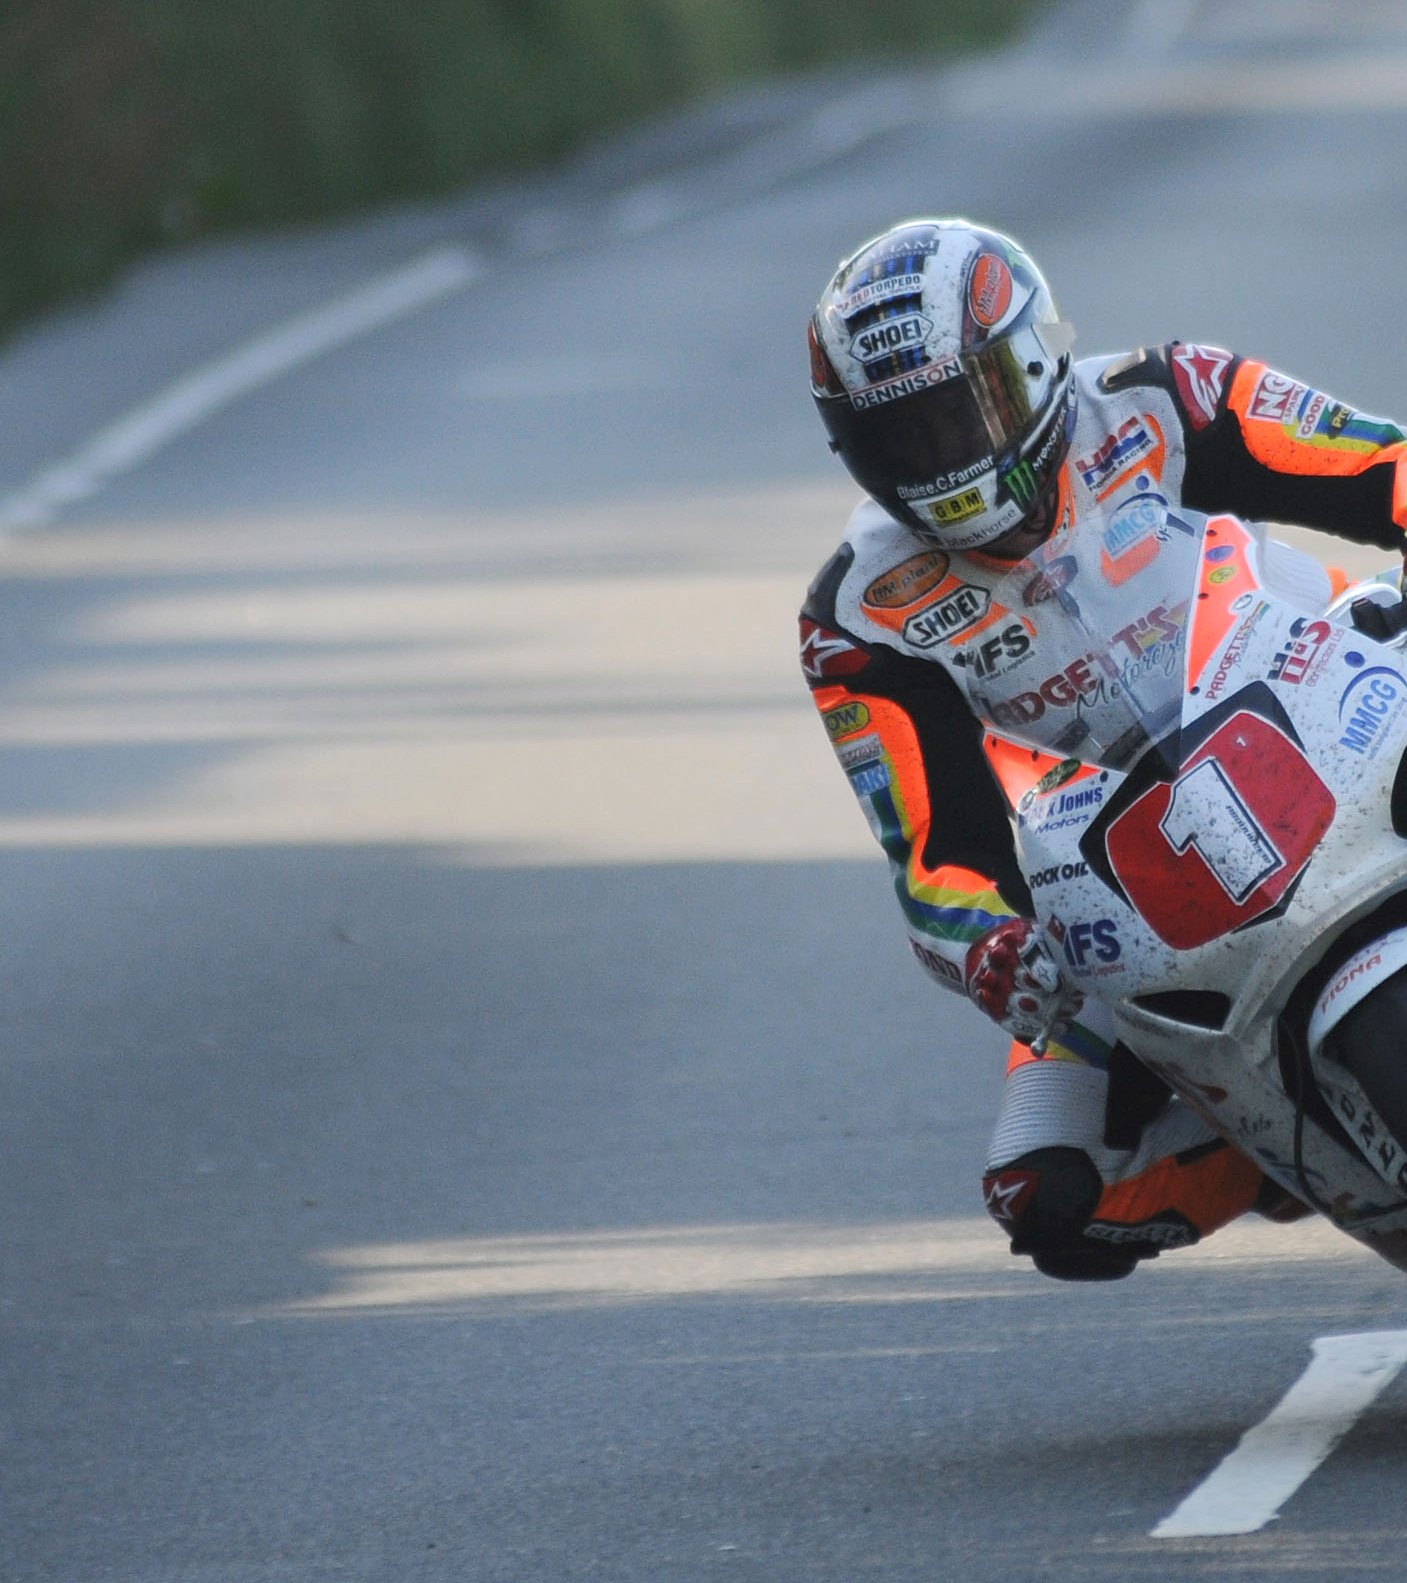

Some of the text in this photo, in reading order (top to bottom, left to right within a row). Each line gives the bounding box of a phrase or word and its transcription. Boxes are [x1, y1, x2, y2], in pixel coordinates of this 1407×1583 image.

[859, 318, 922, 357] SHOEI
[854, 361, 961, 408] DENNISON
[1118, 438, 1153, 466] RACING
[912, 590, 981, 643] SHOEI
[1339, 679, 1397, 755] MMCG
[1034, 814, 1090, 835] Motors
[1159, 756, 1285, 906] 1
[1061, 862, 1089, 881] OIL
[1322, 954, 1381, 1014] FIONA
